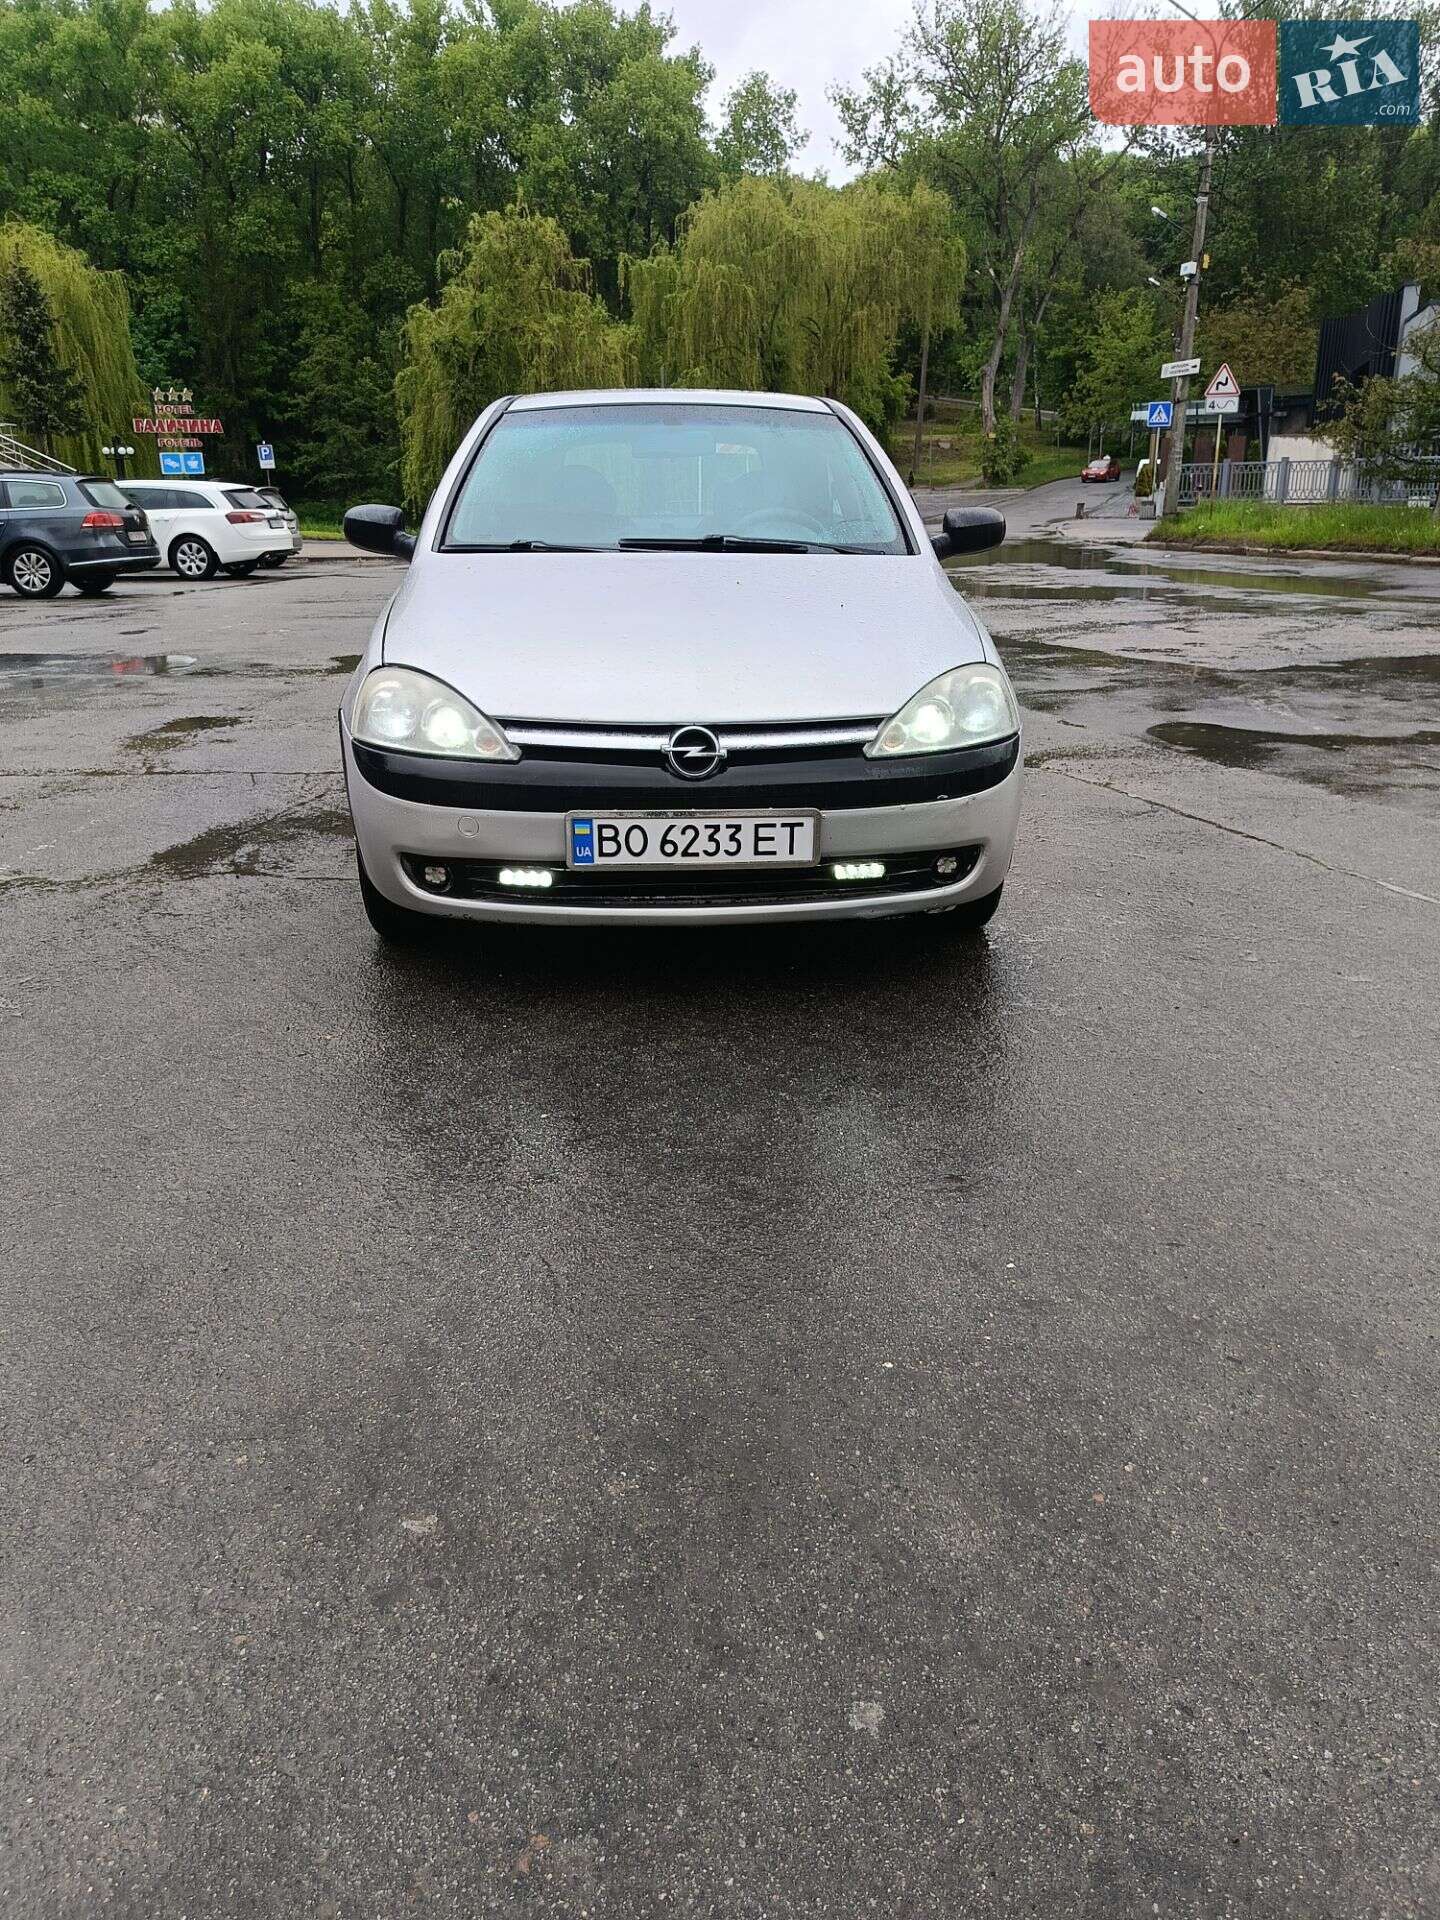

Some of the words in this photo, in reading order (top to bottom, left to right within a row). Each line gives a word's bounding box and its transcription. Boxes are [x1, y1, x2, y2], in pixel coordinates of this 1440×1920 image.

[154, 404, 195, 415] HOTEL
[133, 418, 224, 434] ГАЛИЧИНА
[157, 437, 204, 448] ГОТЕЛЬ
[260, 447, 270, 460] P
[597, 823, 649, 858] BO
[659, 823, 742, 858] 6233
[753, 822, 805, 856] ET
[576, 846, 592, 857] UA
